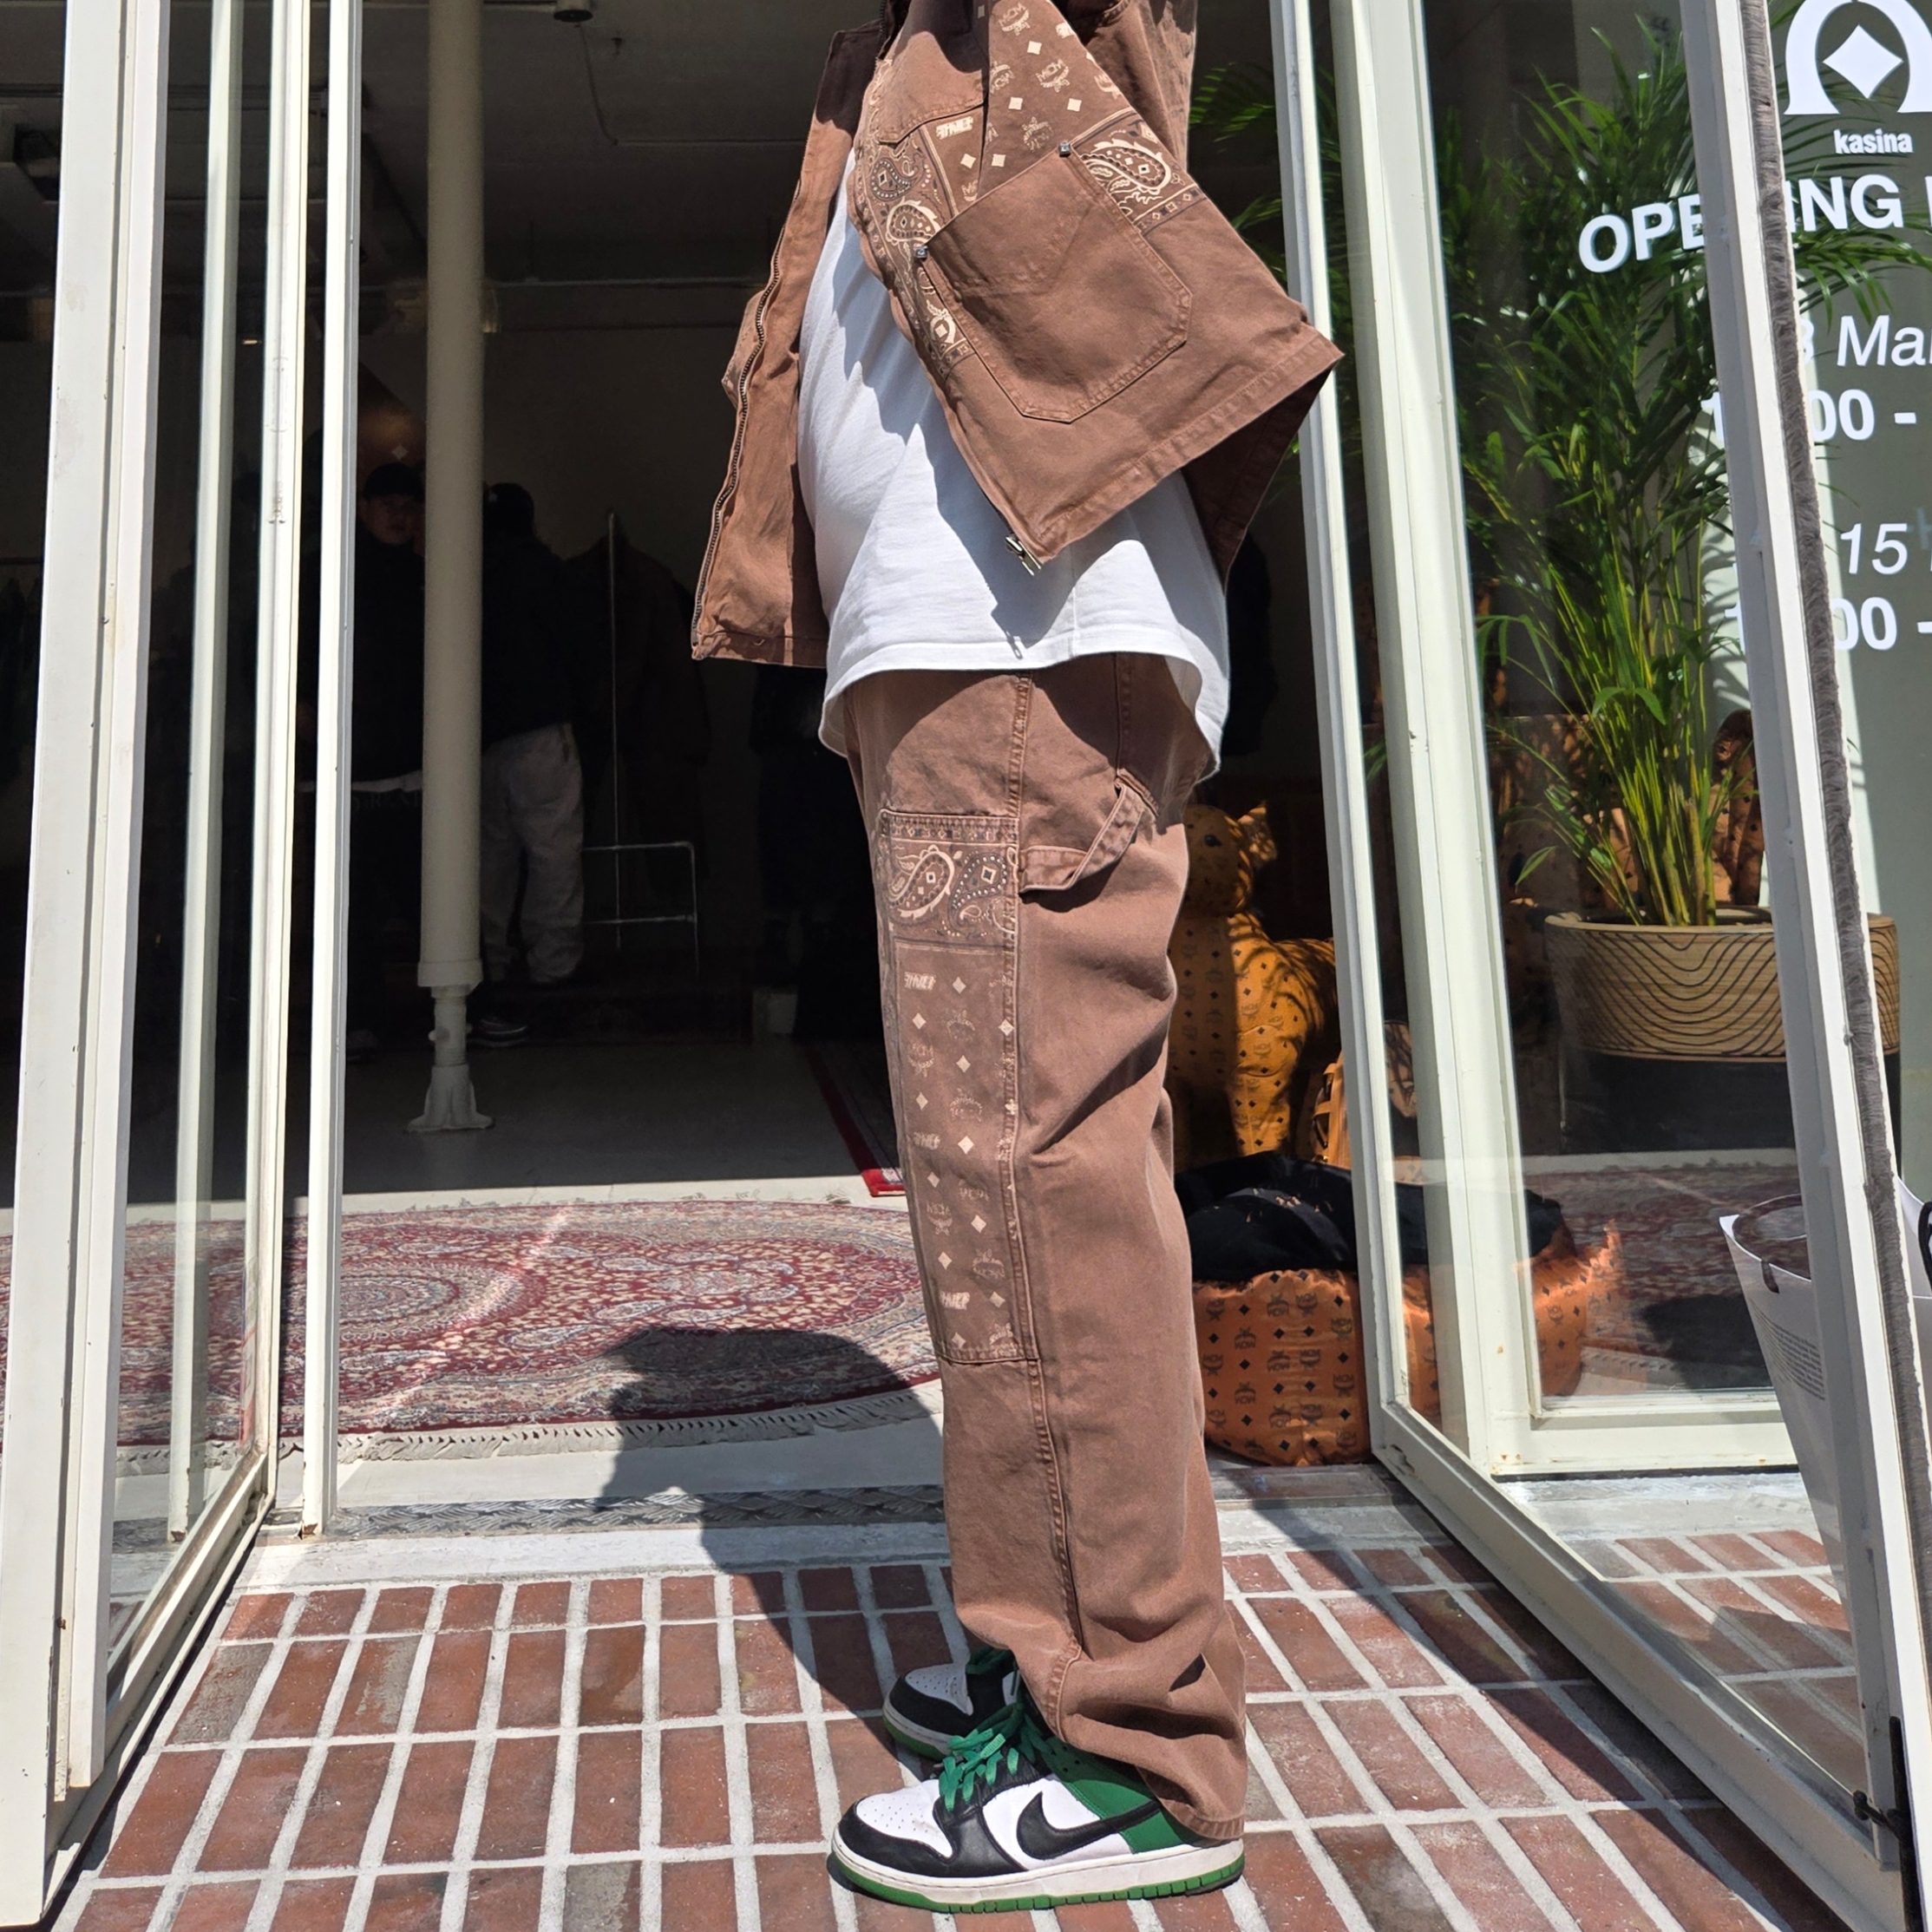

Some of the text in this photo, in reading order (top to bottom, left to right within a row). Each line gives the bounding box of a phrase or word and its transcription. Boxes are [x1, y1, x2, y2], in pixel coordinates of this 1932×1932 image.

[1833, 128, 1914, 154] kasina
[1578, 174, 1904, 273] OPEING
[1837, 314, 1932, 367] Ma
[1840, 522, 1908, 575] 15
